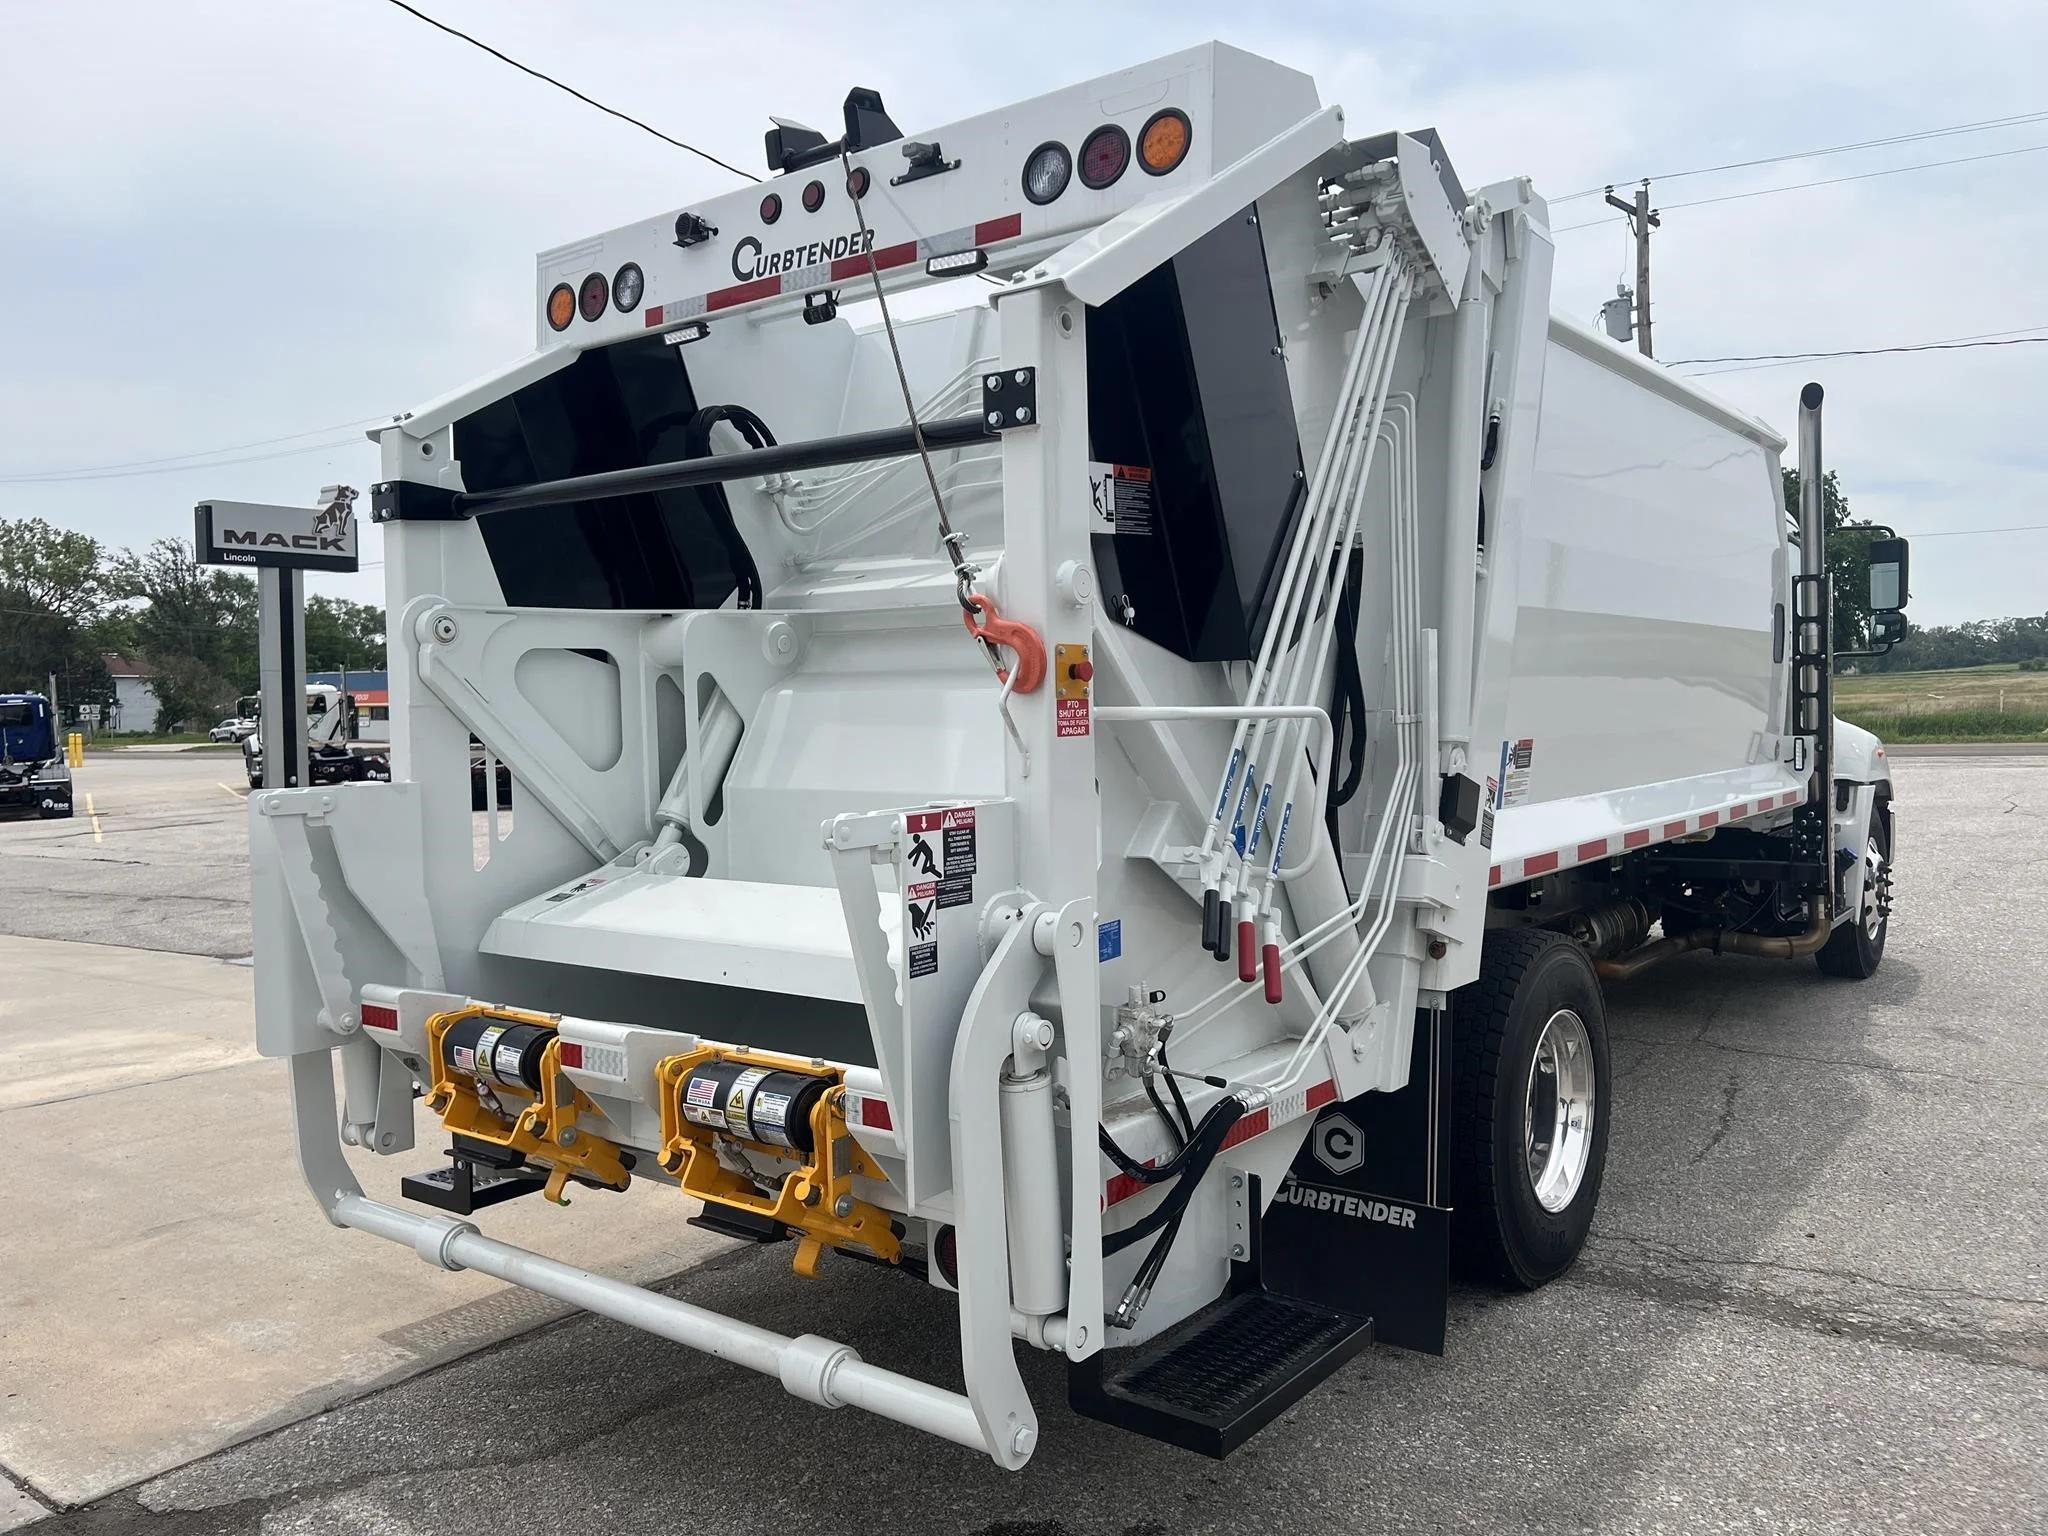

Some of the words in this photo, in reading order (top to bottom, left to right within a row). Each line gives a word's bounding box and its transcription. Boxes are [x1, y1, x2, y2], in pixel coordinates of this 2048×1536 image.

[731, 228, 876, 282] CURBTENDER
[223, 529, 346, 552] MACK
[223, 552, 257, 563] Lincoln
[1067, 700, 1079, 709] PTO
[1058, 709, 1075, 718] SHUT
[1075, 709, 1087, 717] OFF
[1061, 726, 1086, 735] APAGAR
[954, 810, 976, 819] DANGER
[1256, 805, 1267, 834] WINCH
[916, 882, 936, 891] DANGER
